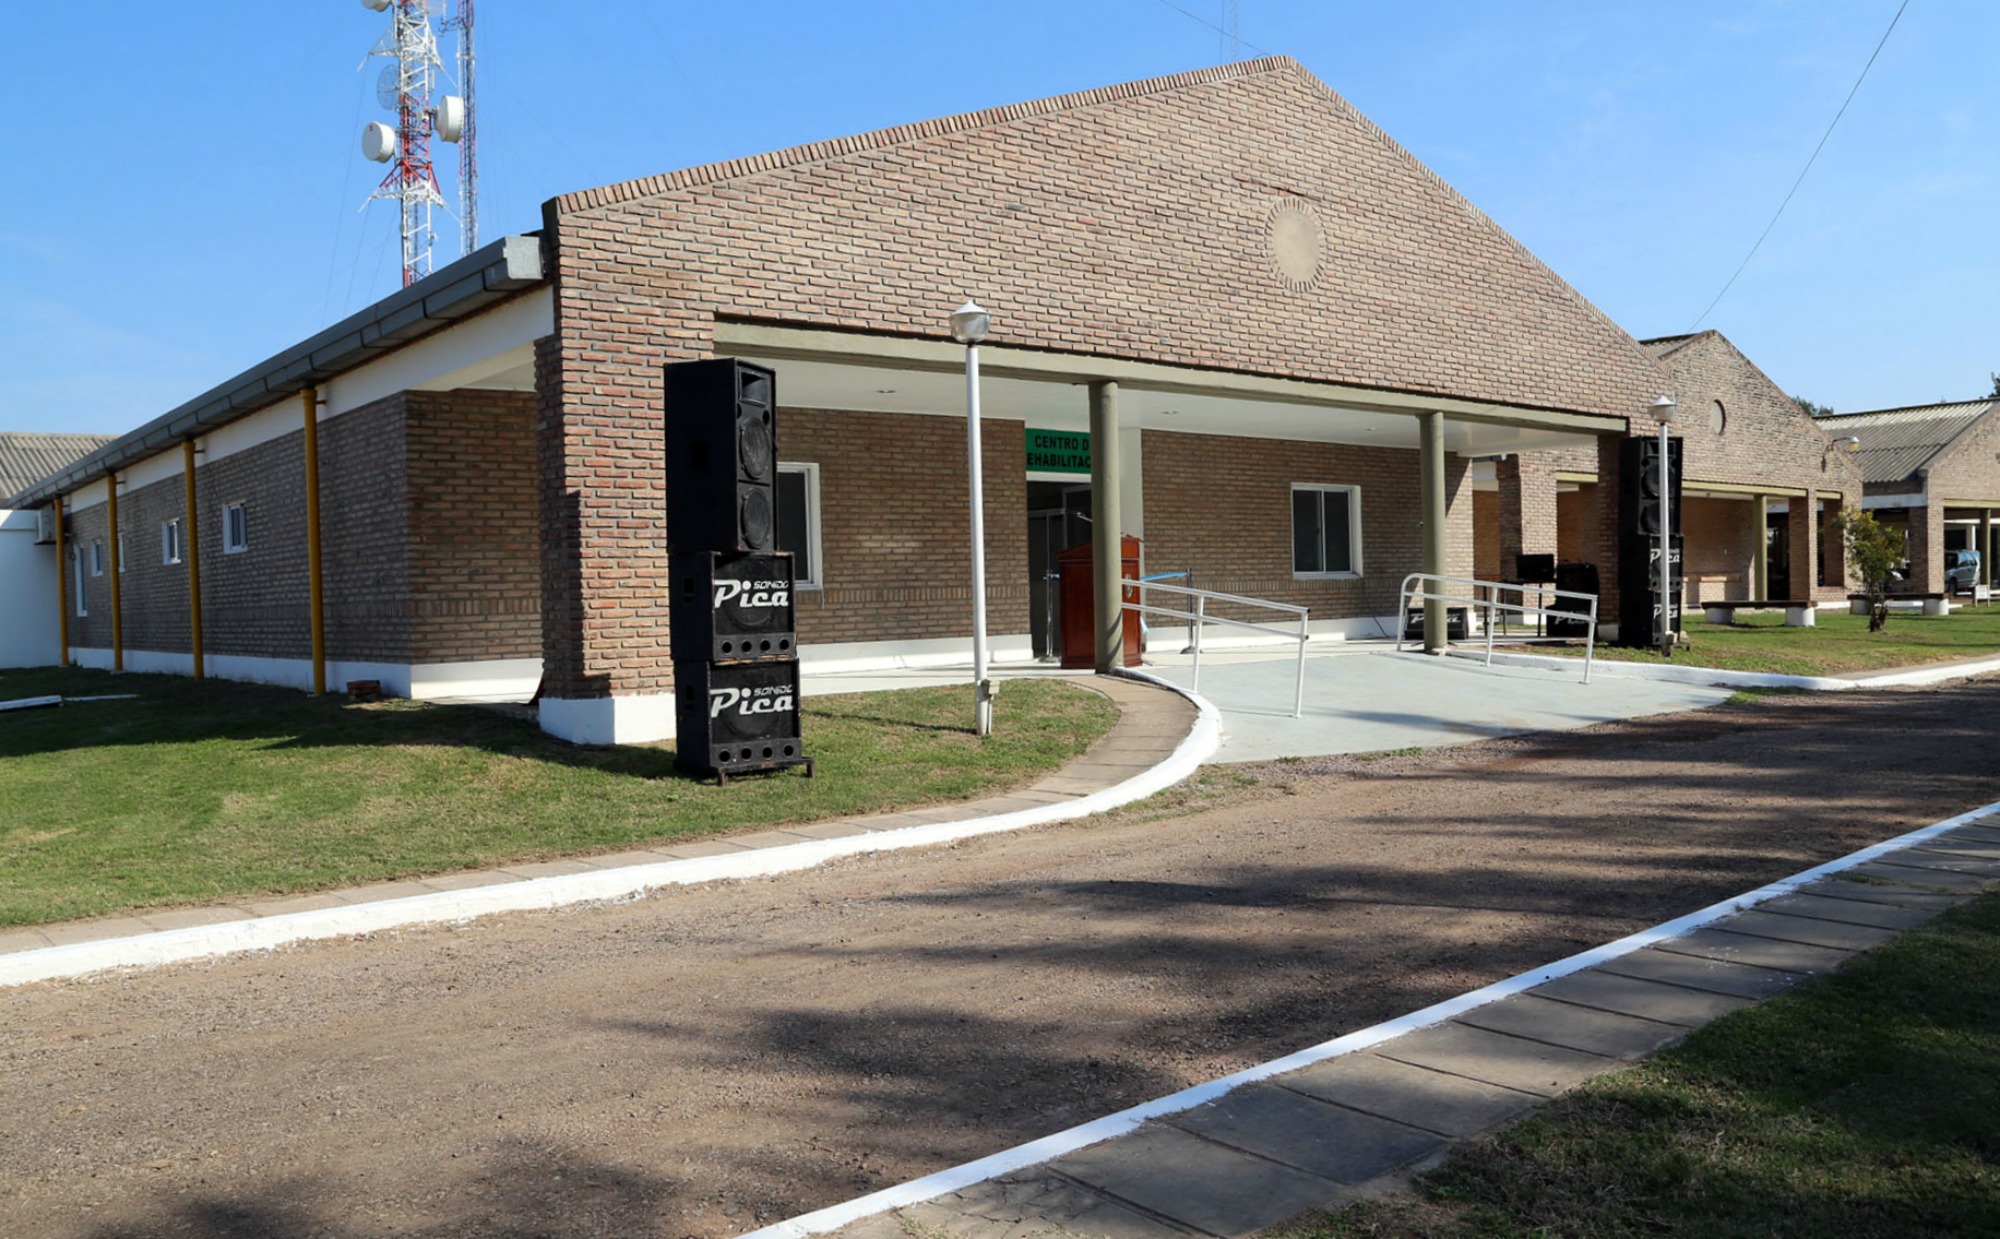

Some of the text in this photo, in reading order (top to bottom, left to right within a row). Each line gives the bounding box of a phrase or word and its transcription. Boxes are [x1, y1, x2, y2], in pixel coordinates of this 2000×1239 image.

[1034, 435, 1079, 450] CENTRO
[1650, 548, 1680, 563] Pca
[753, 580, 789, 590] SONIDO
[713, 579, 789, 608] Pica
[709, 687, 793, 718] Pica
